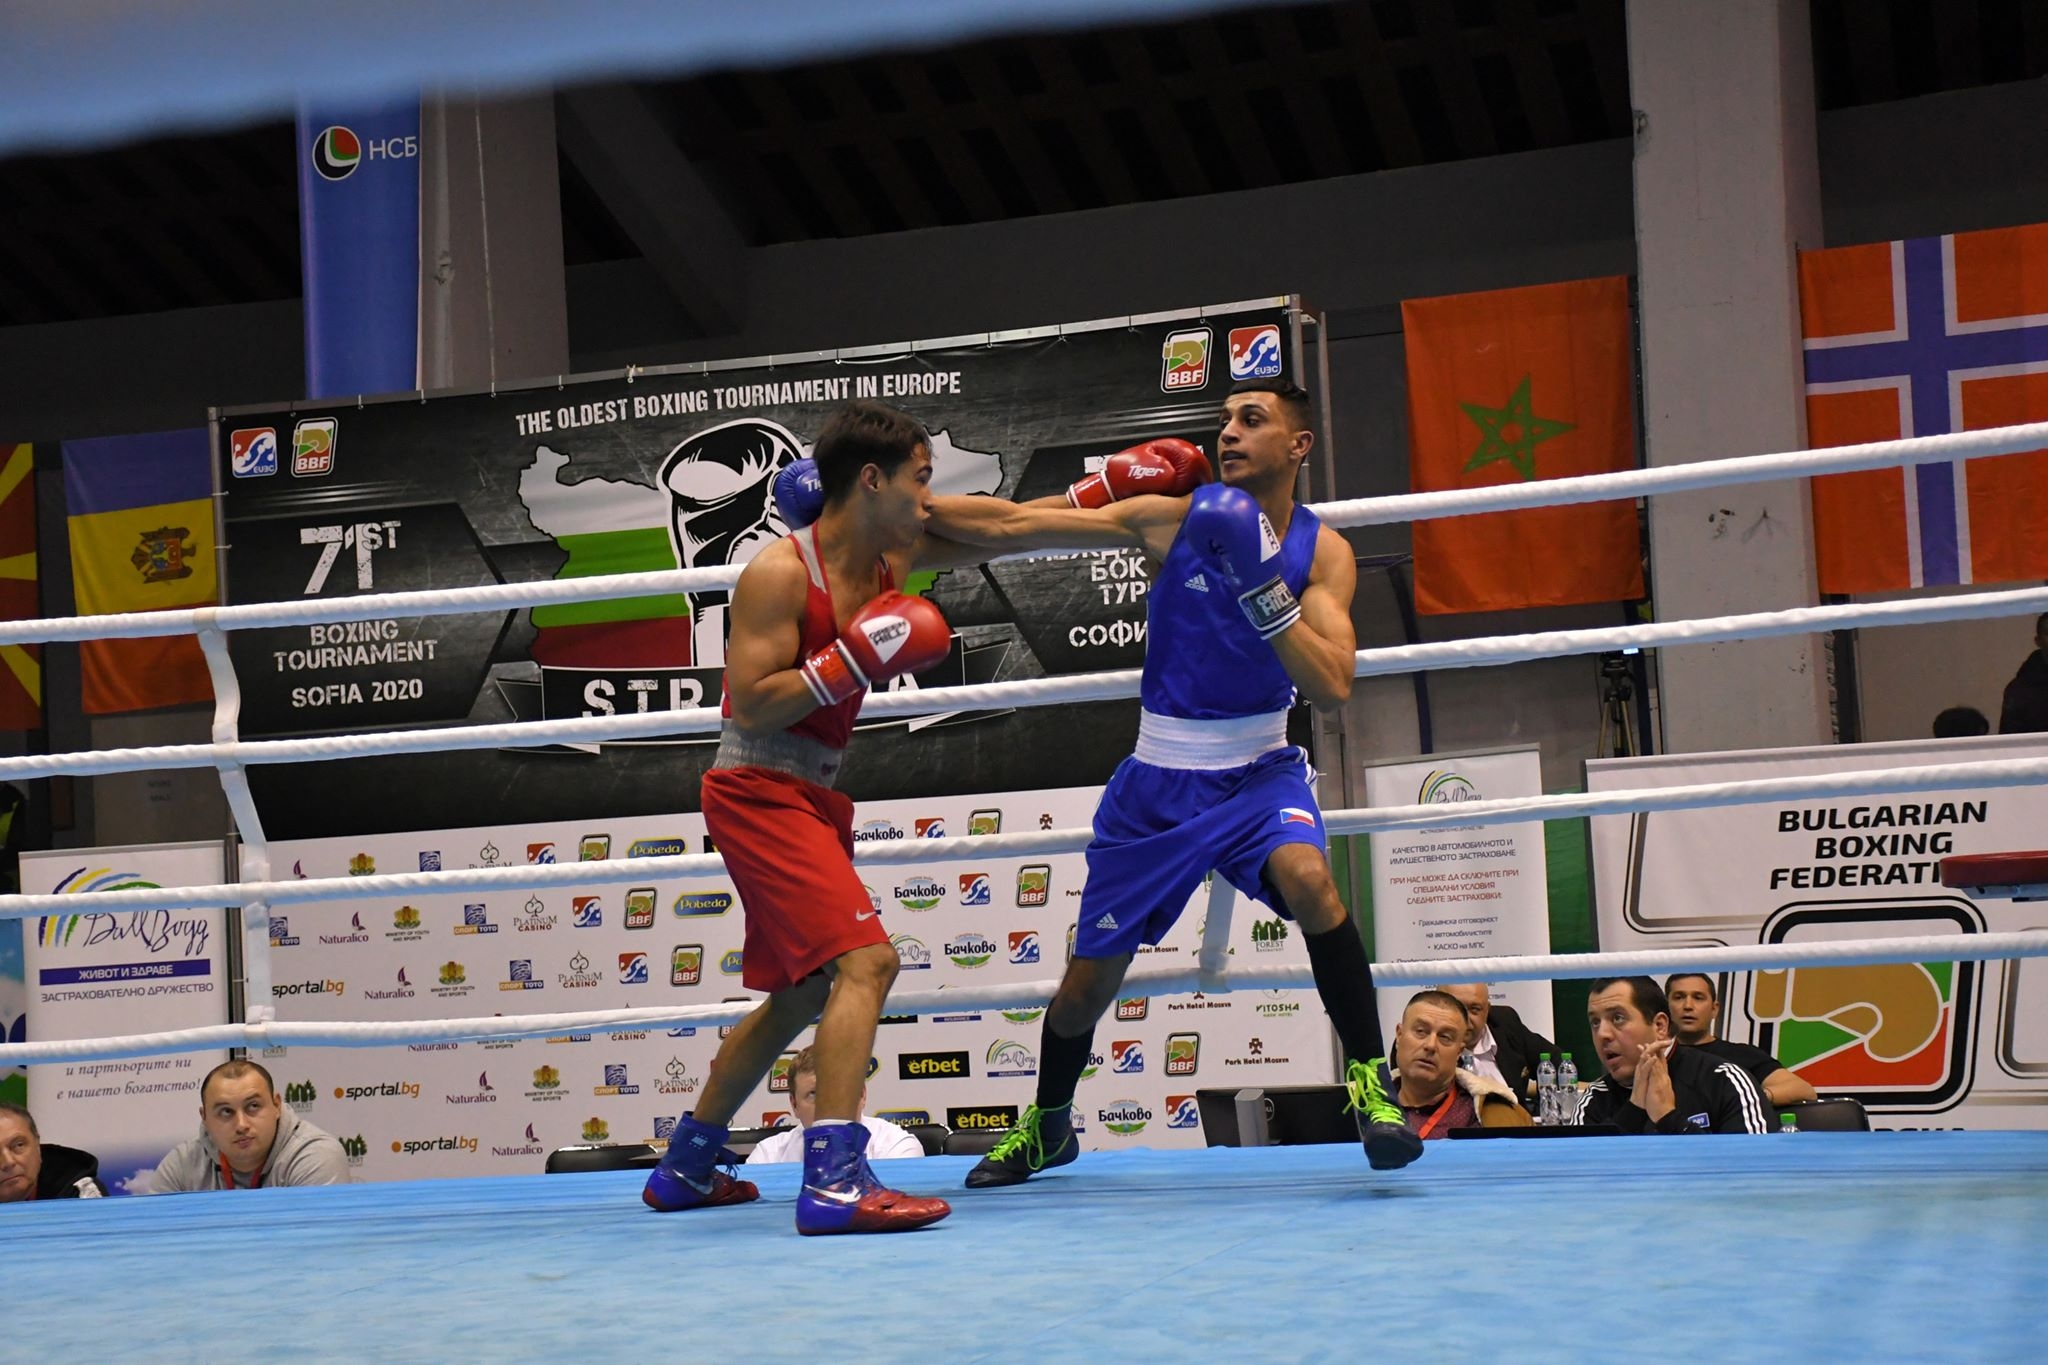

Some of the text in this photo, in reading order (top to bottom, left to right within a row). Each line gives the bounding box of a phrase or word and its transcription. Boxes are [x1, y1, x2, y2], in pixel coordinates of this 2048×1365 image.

[369, 136, 418, 160] НСБ
[1167, 369, 1203, 386] BBF
[516, 371, 962, 436] THE OLDEST BOXING TOURNAMENT IN EUROPE
[297, 456, 330, 471] BBF
[1127, 464, 1165, 480] Tiger
[1184, 581, 1209, 593] adidas
[310, 619, 400, 647] BOXING
[273, 640, 438, 673] TOURNAMENT
[291, 678, 424, 708] SOFIA 2020
[1778, 801, 1988, 832] BULGARIAN
[853, 827, 904, 842] Бачково
[633, 843, 681, 856] Pobeda
[1392, 844, 1430, 854] КАЧЕСТВО
[1437, 839, 1506, 852] АВТОМОБИЛНОТО
[1815, 831, 1953, 860] BOXING
[1459, 849, 1516, 860] ЗАСТРАХОВАНЕ
[1390, 877, 1406, 885] ПРИ
[1407, 875, 1421, 883] НАС
[1422, 874, 1446, 883] МОЖЕ
[1448, 873, 1460, 881] ДА
[1502, 869, 1519, 877] ПРИ
[1769, 861, 1941, 891] FEDERATI
[894, 883, 946, 898] Бачково
[1020, 892, 1044, 902] BBF
[680, 898, 727, 911] Pobeda
[513, 915, 558, 927] PLATINUM
[628, 915, 651, 925] BBF
[1096, 922, 1119, 930] adidas
[518, 923, 552, 932] CASINO
[319, 933, 369, 945] Naturalico
[1256, 940, 1284, 949] FOREST
[944, 940, 997, 955] Бачково
[1433, 943, 1458, 951] КАСКО
[79, 964, 173, 980] ЖИВОТ И ЗДРАВЕ
[558, 972, 602, 984] PLATINUM
[674, 971, 697, 982] BBF
[272, 979, 345, 998] sportal.bg
[563, 980, 597, 988] CASINO
[41, 982, 215, 1002] ЗАСТРАХОВАТЕЛНО ДРУЖЕСТВО
[365, 988, 415, 1000] Naturalico
[1119, 1006, 1144, 1017] BBF
[1256, 1002, 1300, 1013] VITOSHA
[611, 1033, 647, 1041] CASINO
[408, 1042, 459, 1052] Naturalico
[66, 1058, 192, 1078] и партньорите ни
[907, 1057, 961, 1074] efbet
[1168, 1061, 1194, 1072] BBF
[56, 1078, 202, 1100] е нашето богатство!
[654, 1077, 699, 1089] PLATINUM
[771, 1078, 789, 1088] BB
[346, 1081, 421, 1100] sportal.bg
[659, 1086, 694, 1094] CASINO
[446, 1093, 497, 1105] Naturalico
[956, 1113, 1010, 1128] efbet
[1098, 1106, 1153, 1122] Бачково
[403, 1136, 478, 1155] sportal.bg
[492, 1145, 543, 1157] Naturalico
[811, 1139, 829, 1150] NIKE
